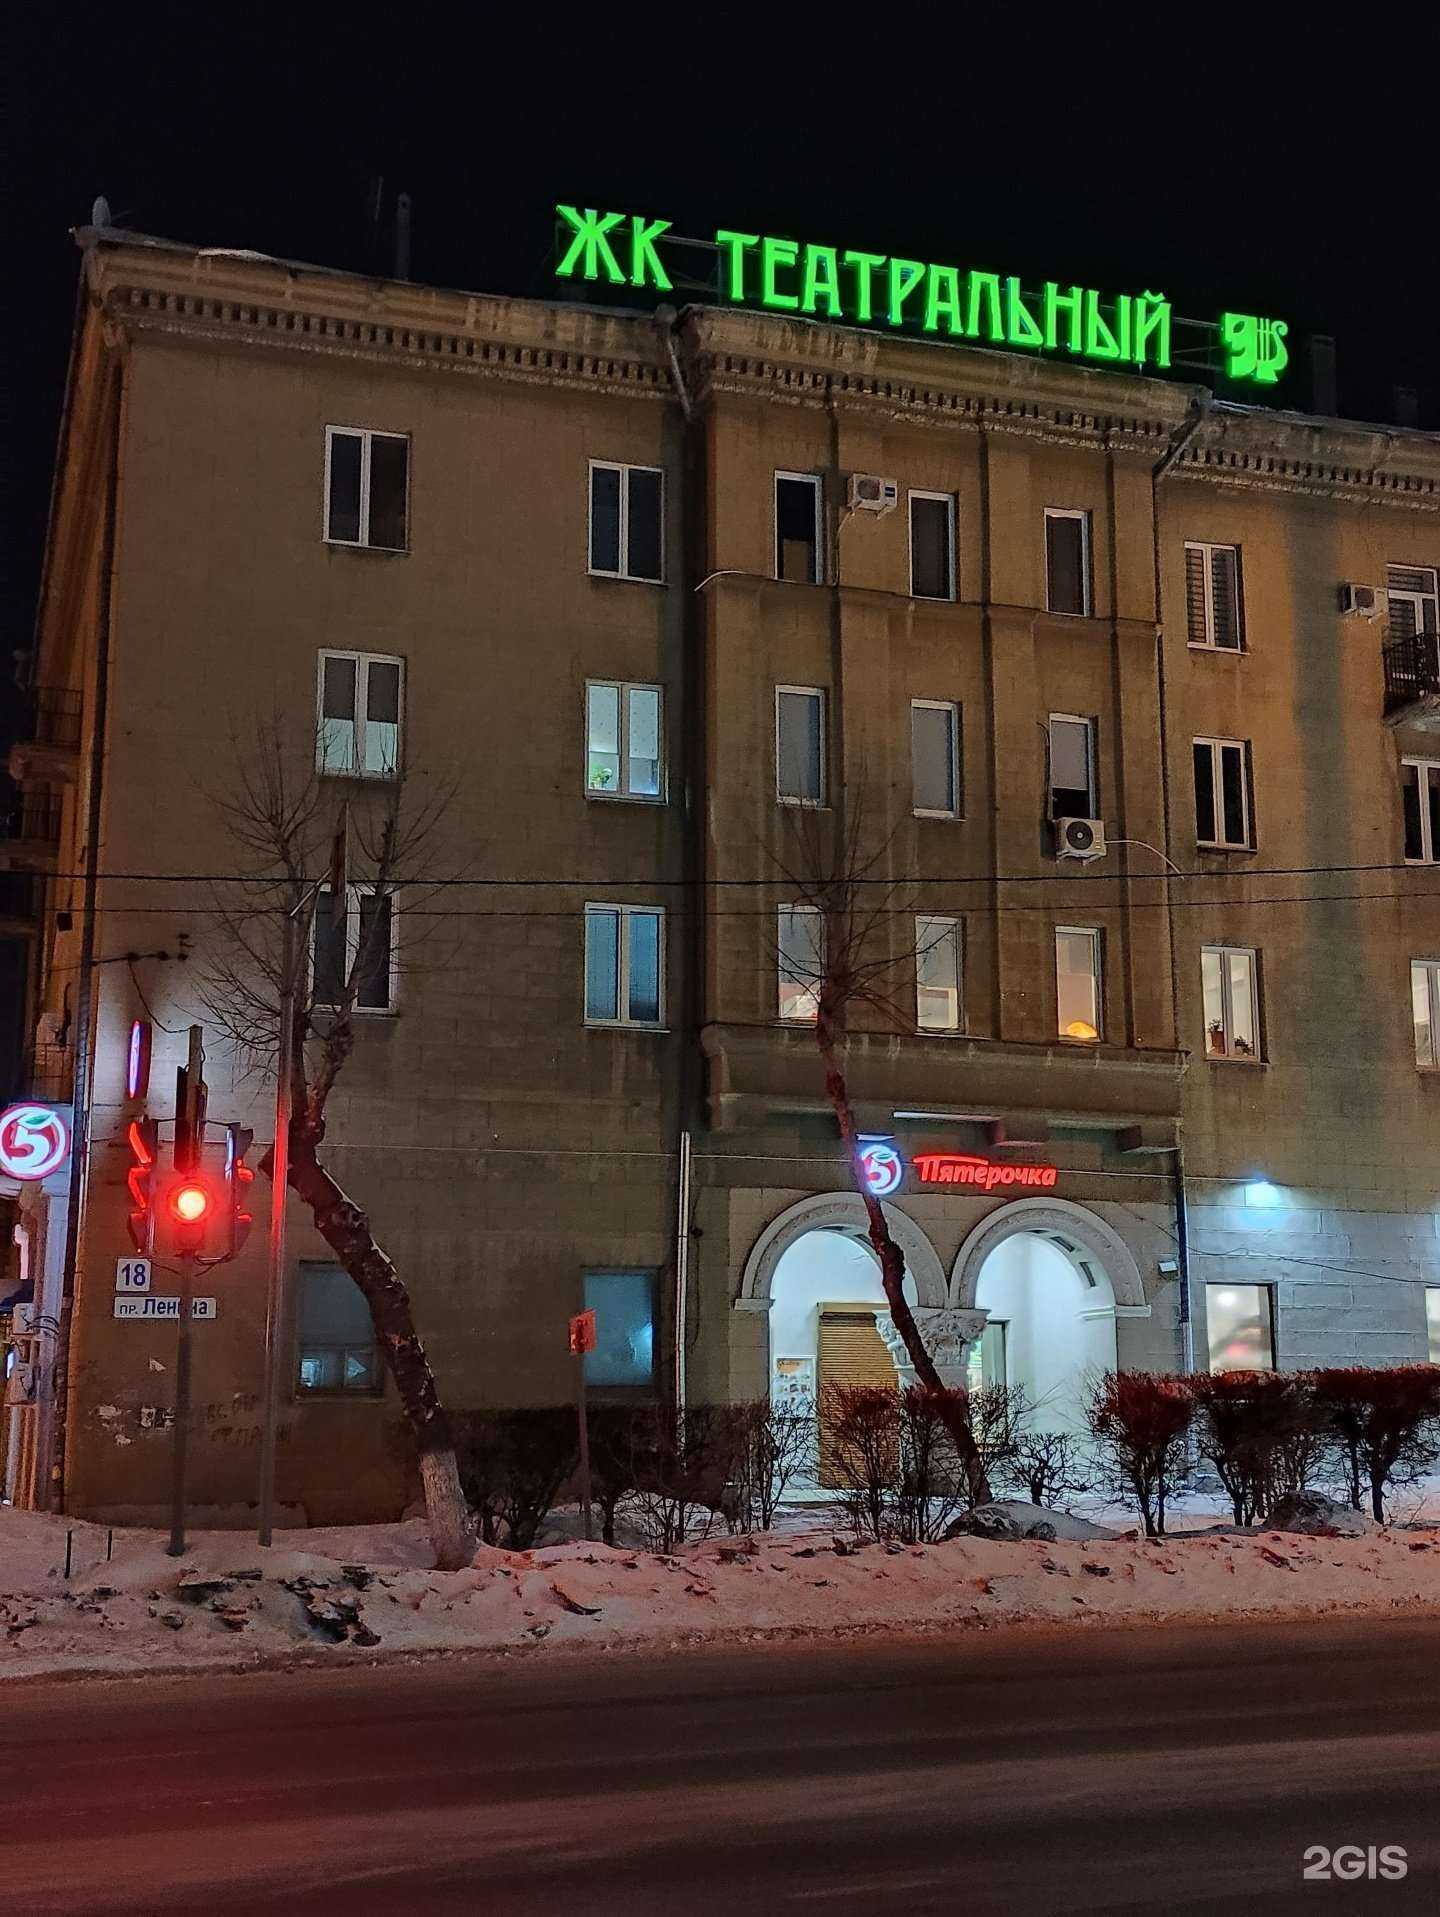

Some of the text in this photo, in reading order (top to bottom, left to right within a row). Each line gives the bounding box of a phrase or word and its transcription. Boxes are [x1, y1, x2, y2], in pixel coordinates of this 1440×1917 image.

[555, 204, 1171, 367] ЖК ТЕАТРАЛЬНЫЙ
[10, 1123, 51, 1169] 5
[912, 1155, 1057, 1190] Пятерочка
[121, 1263, 146, 1287] 18
[142, 1299, 208, 1315] Ленна
